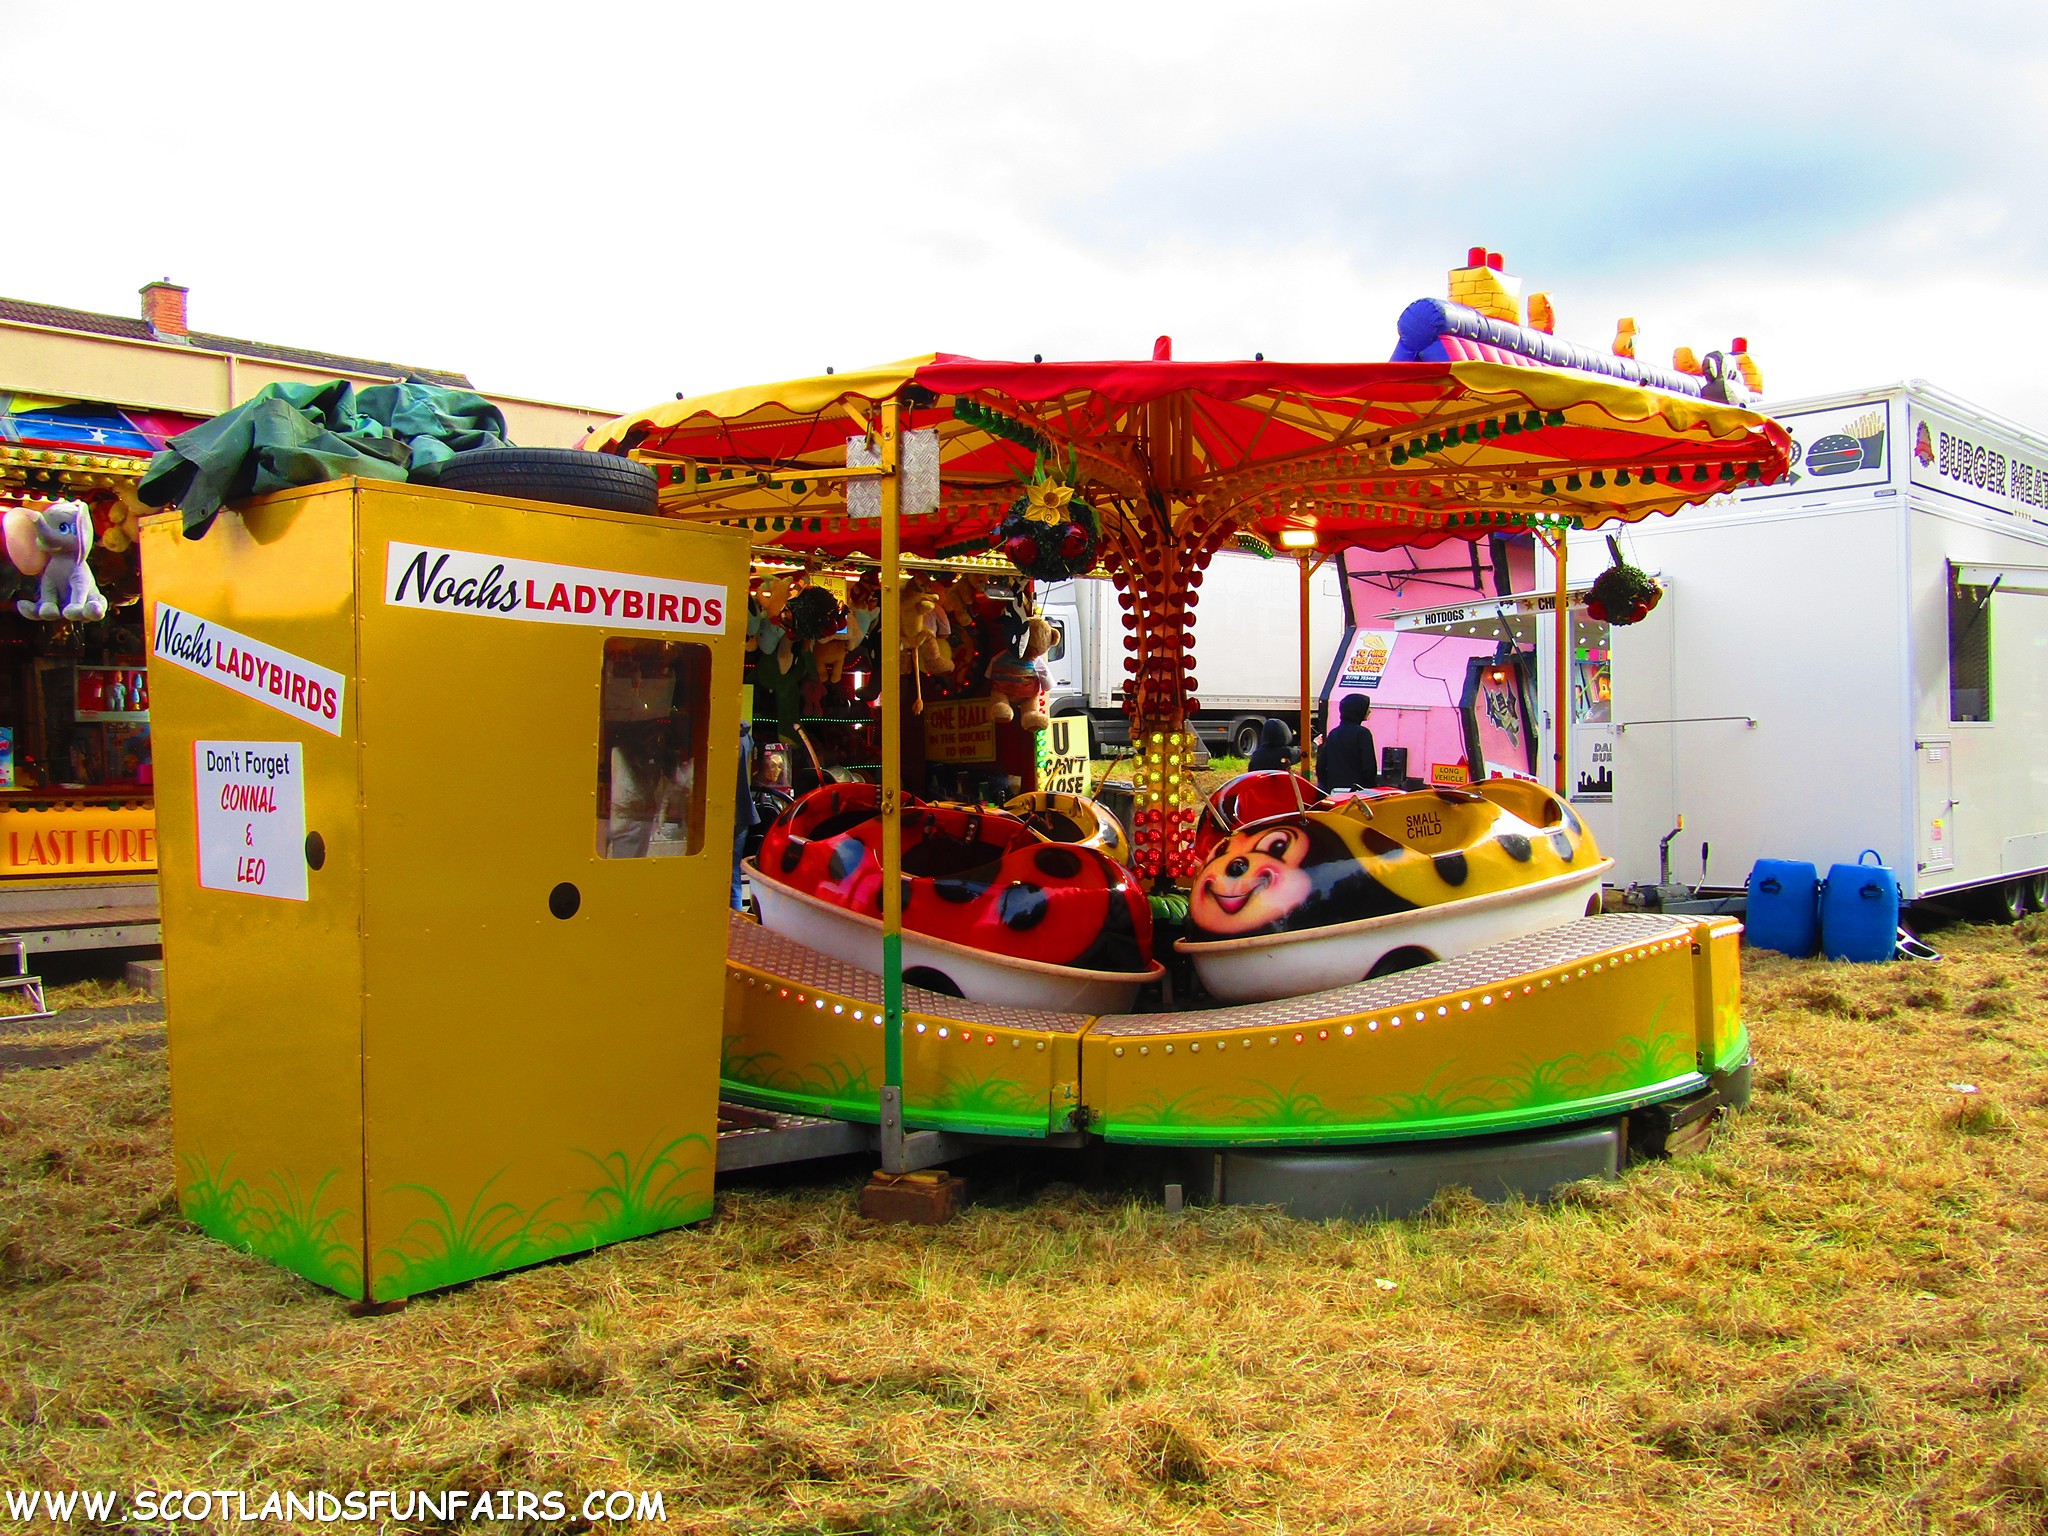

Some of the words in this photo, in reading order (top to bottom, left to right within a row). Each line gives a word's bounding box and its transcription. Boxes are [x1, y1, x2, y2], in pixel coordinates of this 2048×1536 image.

[1940, 431, 2006, 496] BURGER
[394, 550, 522, 613] Noahs
[524, 579, 723, 627] LADYBIRDS
[1424, 609, 1465, 625] HOTDOGS
[154, 608, 213, 668] Noahs
[215, 640, 337, 720] LADYBIRDS
[1348, 664, 1383, 672] CONTACT
[931, 707, 955, 729] ONE
[940, 733, 956, 744] THE
[958, 730, 991, 743] BUCKET
[1052, 722, 1070, 756] U
[1594, 742, 1612, 752] DA
[945, 746, 956, 757] TO
[206, 750, 240, 773] Don't
[245, 750, 290, 780] Forget
[1439, 767, 1460, 775] LONG
[1434, 774, 1465, 783] VEHICLE
[221, 783, 277, 813] CONNAL
[1406, 811, 1442, 827] SMALL
[245, 823, 254, 847] &
[1406, 823, 1443, 839] CHILD
[9, 829, 78, 866] LAST
[86, 828, 157, 864] FORE
[237, 856, 266, 885] LEO
